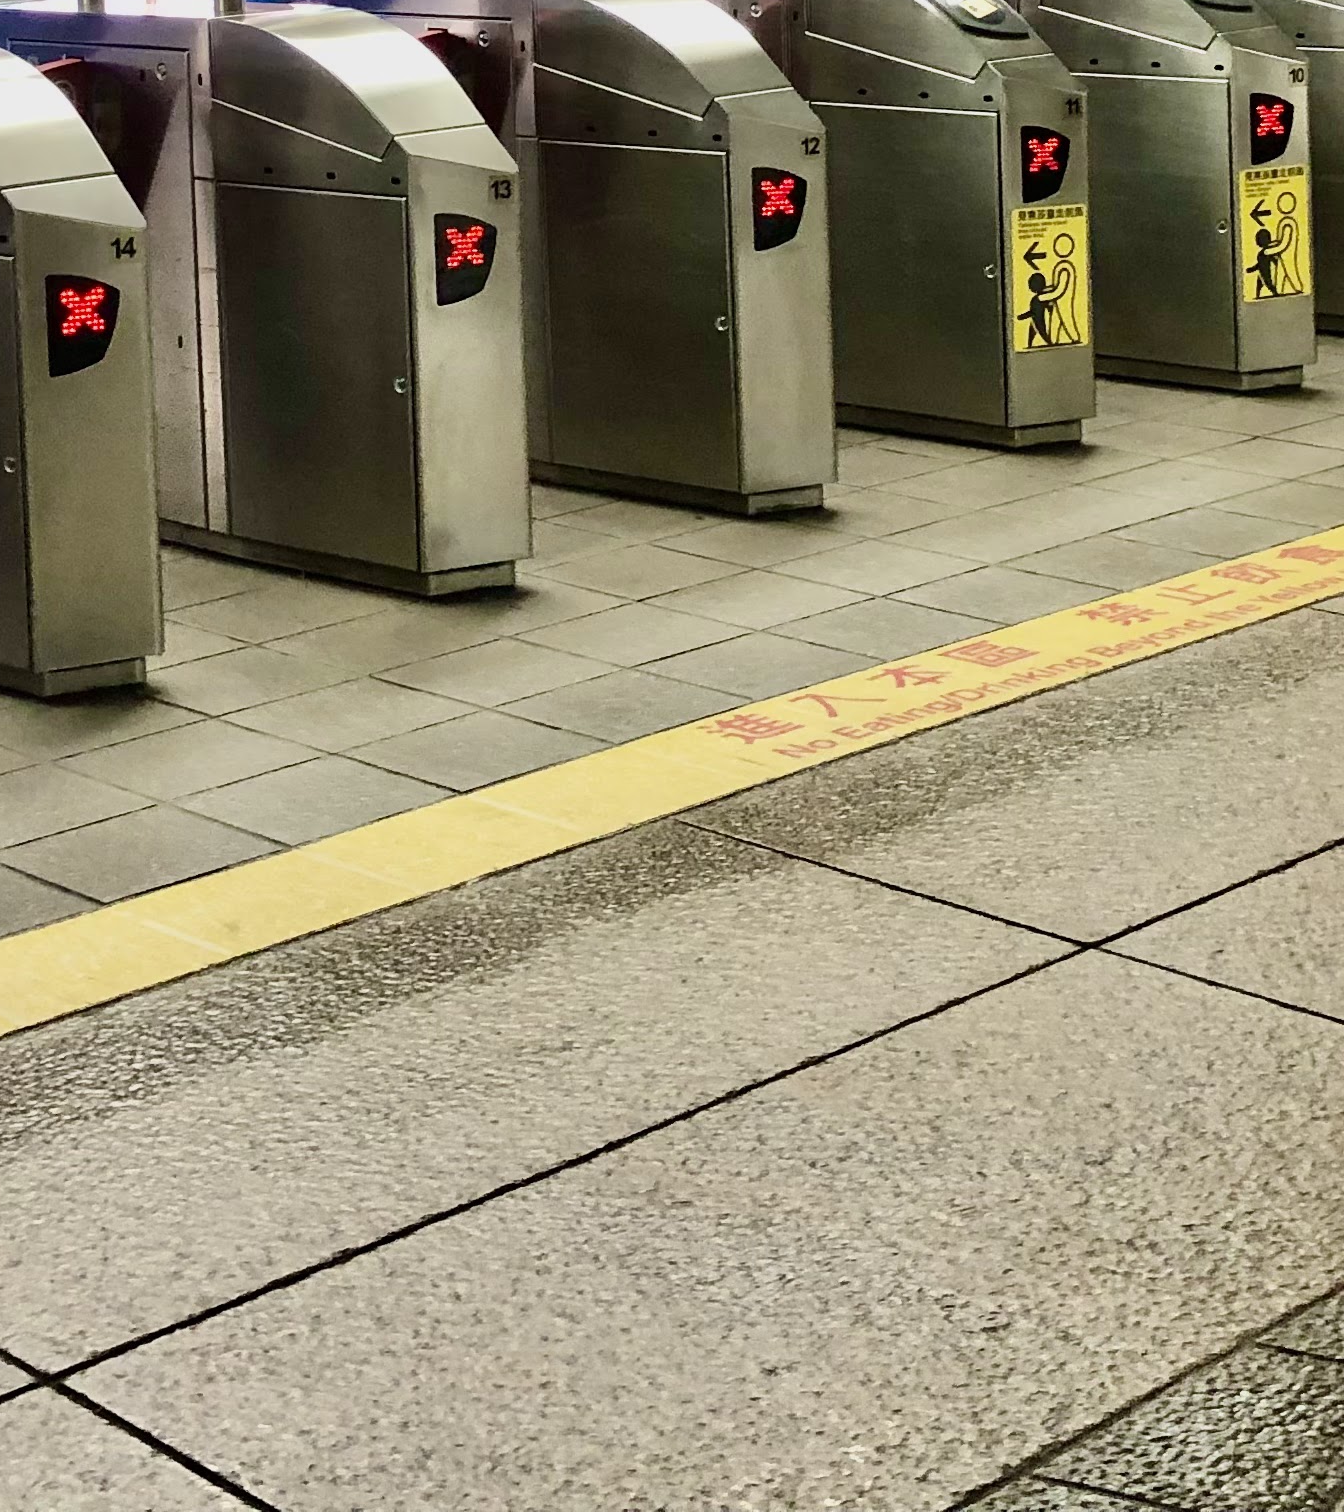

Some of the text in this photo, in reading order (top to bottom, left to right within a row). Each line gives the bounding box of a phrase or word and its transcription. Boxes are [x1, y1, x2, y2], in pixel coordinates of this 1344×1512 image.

[1289, 67, 1305, 83] 10
[1065, 98, 1081, 115] 11
[801, 137, 820, 155] 12
[491, 180, 512, 199] 13
[111, 236, 136, 259] 14
[773, 739, 838, 759] No
[832, 656, 1103, 740] Eating/Drinking
[1087, 619, 1210, 658] Beyond
[1204, 602, 1261, 626] the
[1257, 574, 1344, 605] Yellow
[697, 640, 1040, 744] 進入本區
